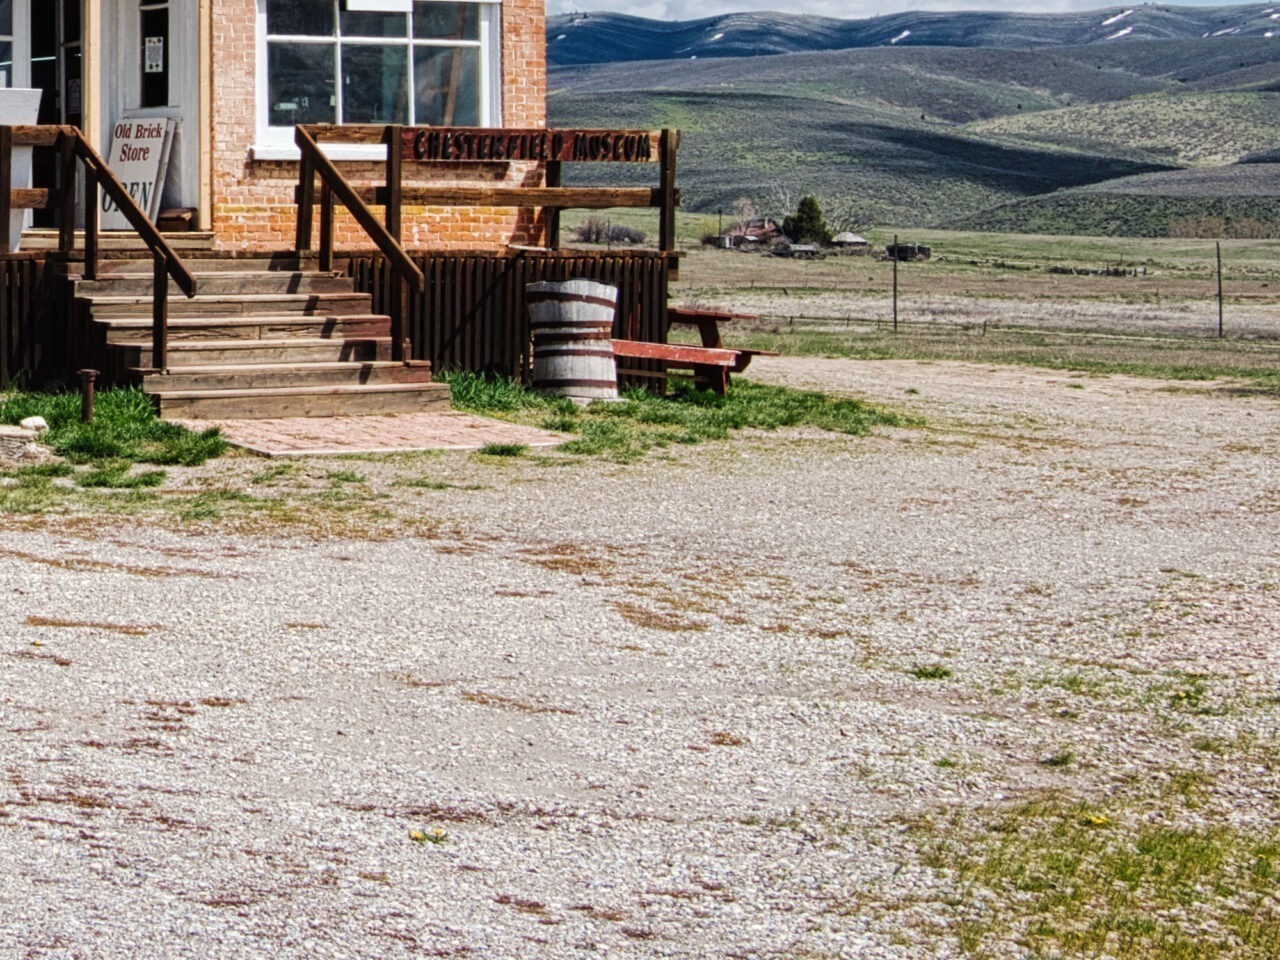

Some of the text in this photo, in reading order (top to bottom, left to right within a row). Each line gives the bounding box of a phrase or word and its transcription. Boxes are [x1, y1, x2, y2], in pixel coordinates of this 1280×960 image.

[114, 124, 162, 139] Old Brick
[119, 143, 150, 162] Store
[413, 130, 652, 161] CHESTERFIELD MUSEUM
